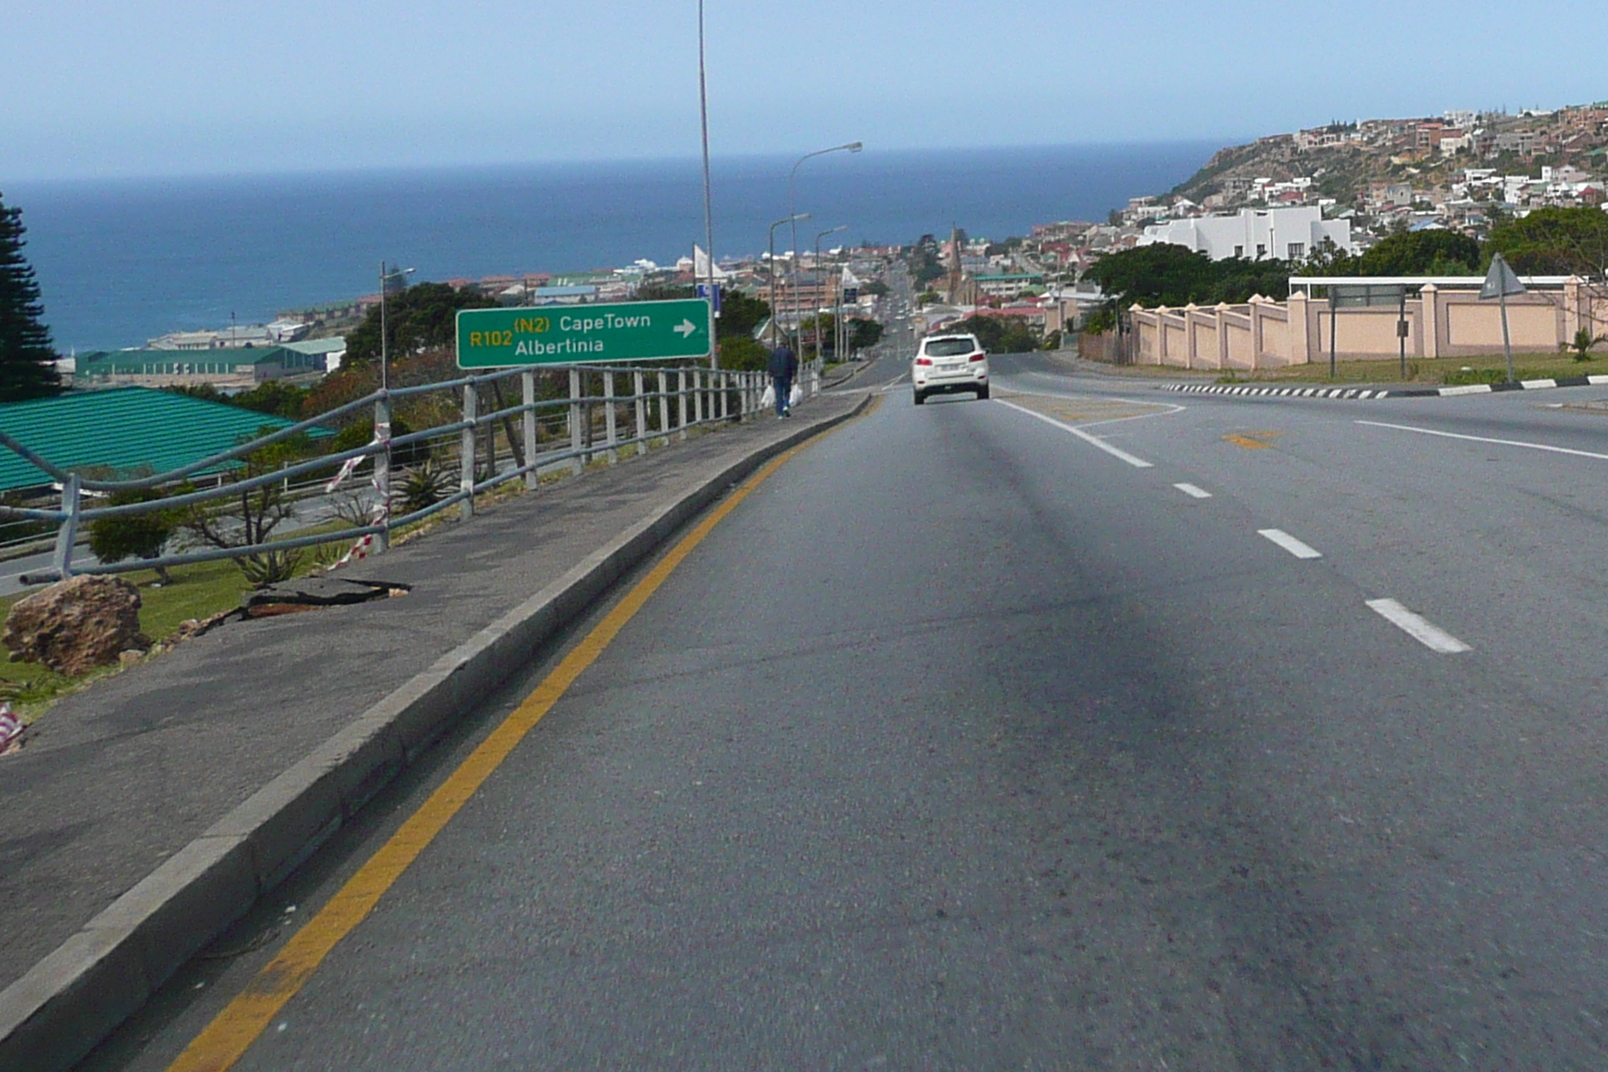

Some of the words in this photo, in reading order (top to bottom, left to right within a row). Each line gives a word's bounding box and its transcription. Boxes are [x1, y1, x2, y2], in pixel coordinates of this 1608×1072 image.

[514, 317, 550, 334] (N2)
[470, 331, 513, 347] R102
[515, 338, 604, 356] Albertinia
